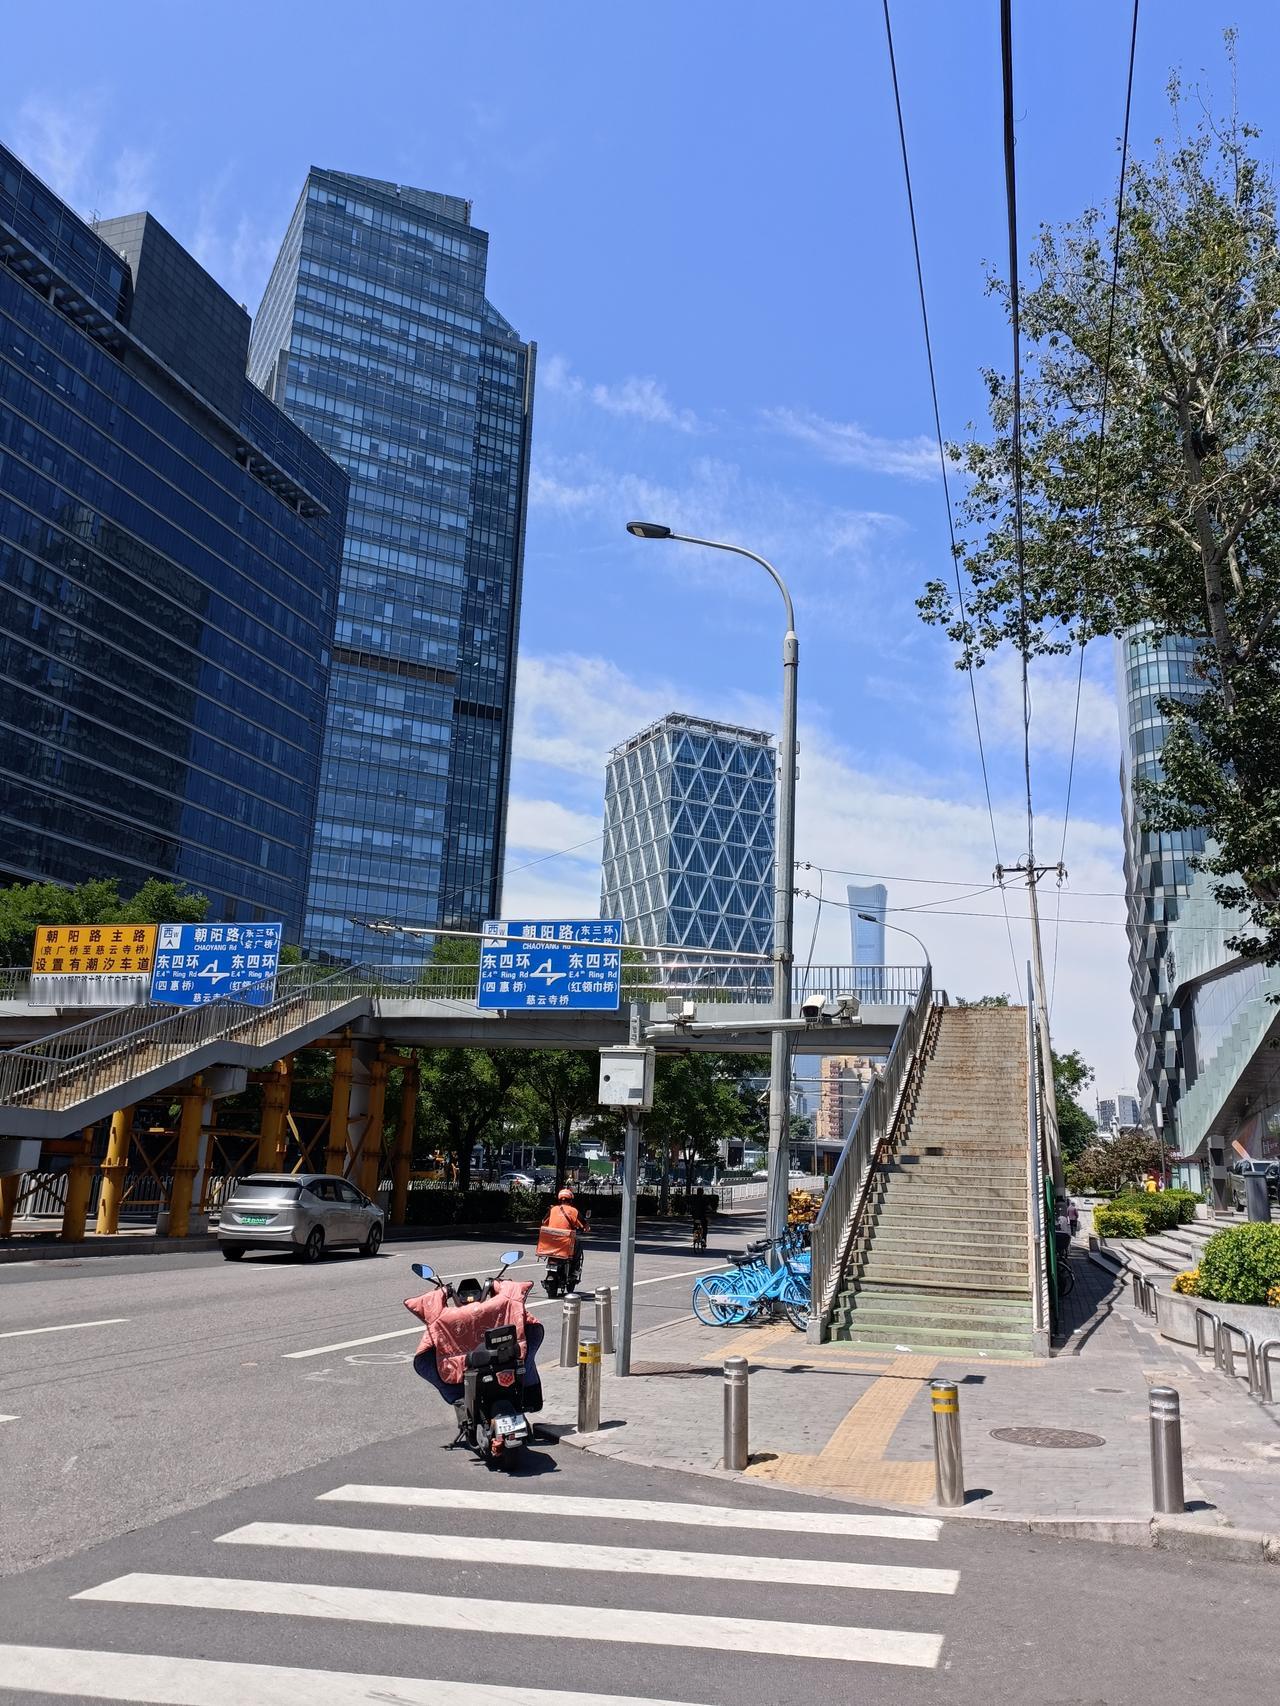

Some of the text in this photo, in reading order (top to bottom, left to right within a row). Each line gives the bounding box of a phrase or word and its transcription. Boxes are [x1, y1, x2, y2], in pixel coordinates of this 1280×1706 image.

[164, 927, 174, 938] 西
[487, 924, 499, 934] 西
[522, 925, 573, 940] 朝阳路
[581, 925, 614, 935] 东三环
[46, 930, 145, 943] 朝阳路主路
[194, 928, 240, 942] 朝阳路
[41, 945, 148, 955] (京广桥至慈云寺桥)
[36, 958, 149, 971] 设置有潮汐车道
[157, 954, 200, 969] 东四环
[231, 954, 275, 969] 东四环
[482, 954, 531, 969] 东四环
[569, 953, 618, 969] 东四环
[173, 970, 186, 979] Ring
[248, 970, 262, 979] Ring
[501, 970, 516, 980] Ring
[520, 970, 529, 978] Rd
[589, 970, 604, 980] Ring
[608, 970, 617, 978] Rd
[155, 981, 195, 991] (四惠桥)
[482, 982, 527, 992] (四惠桥)
[567, 981, 618, 992] (红领巾桥)
[526, 994, 569, 1006] 慈云寺桥
